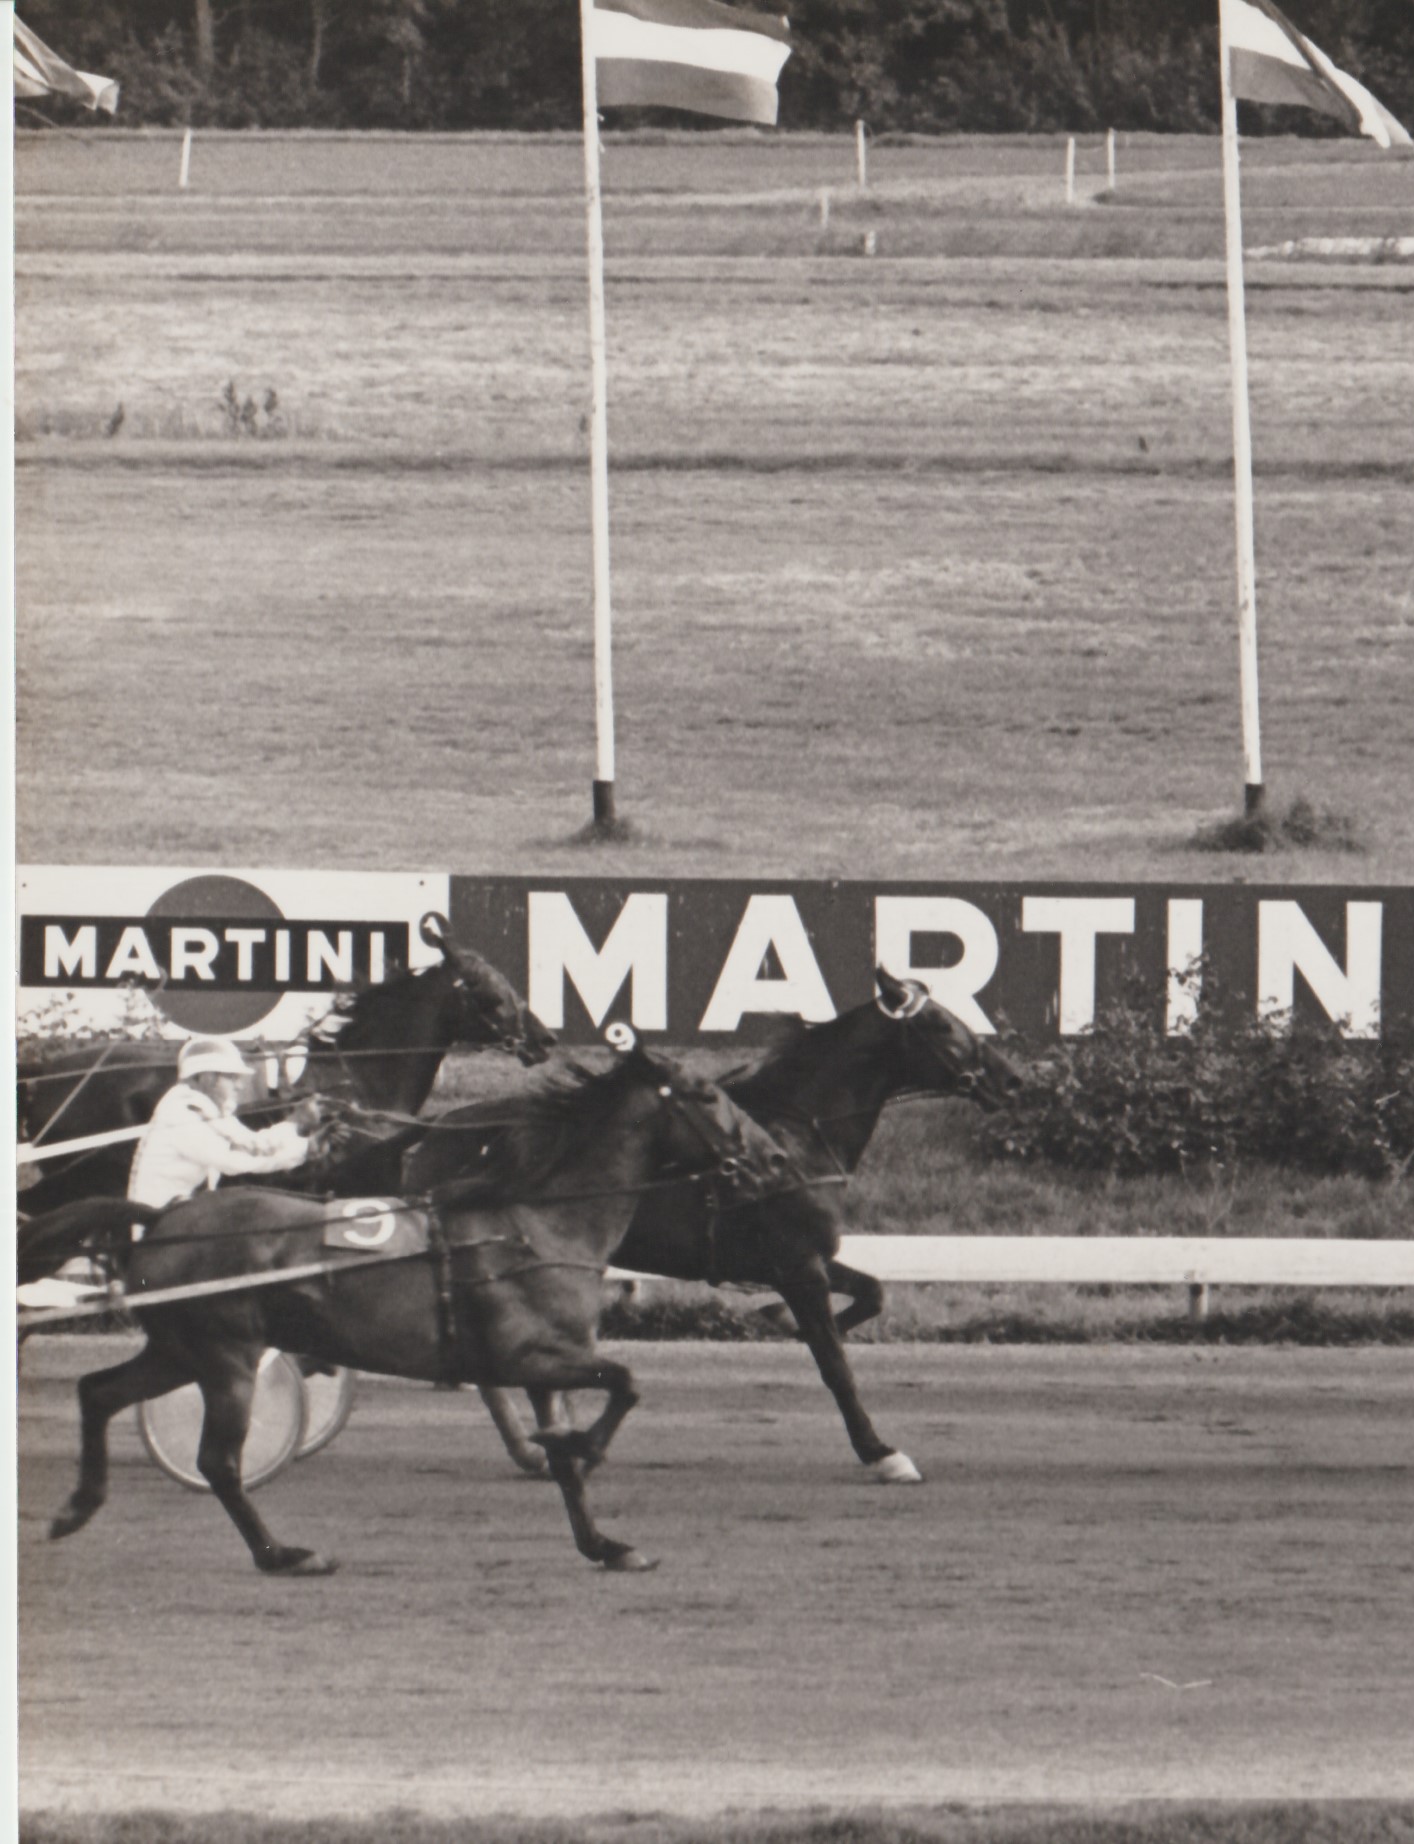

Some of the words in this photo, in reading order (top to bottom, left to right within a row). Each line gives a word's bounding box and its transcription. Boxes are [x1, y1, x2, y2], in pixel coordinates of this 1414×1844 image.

[44, 925, 385, 984] MARTINI
[605, 1021, 636, 1052] 9
[343, 1199, 396, 1246] 9
